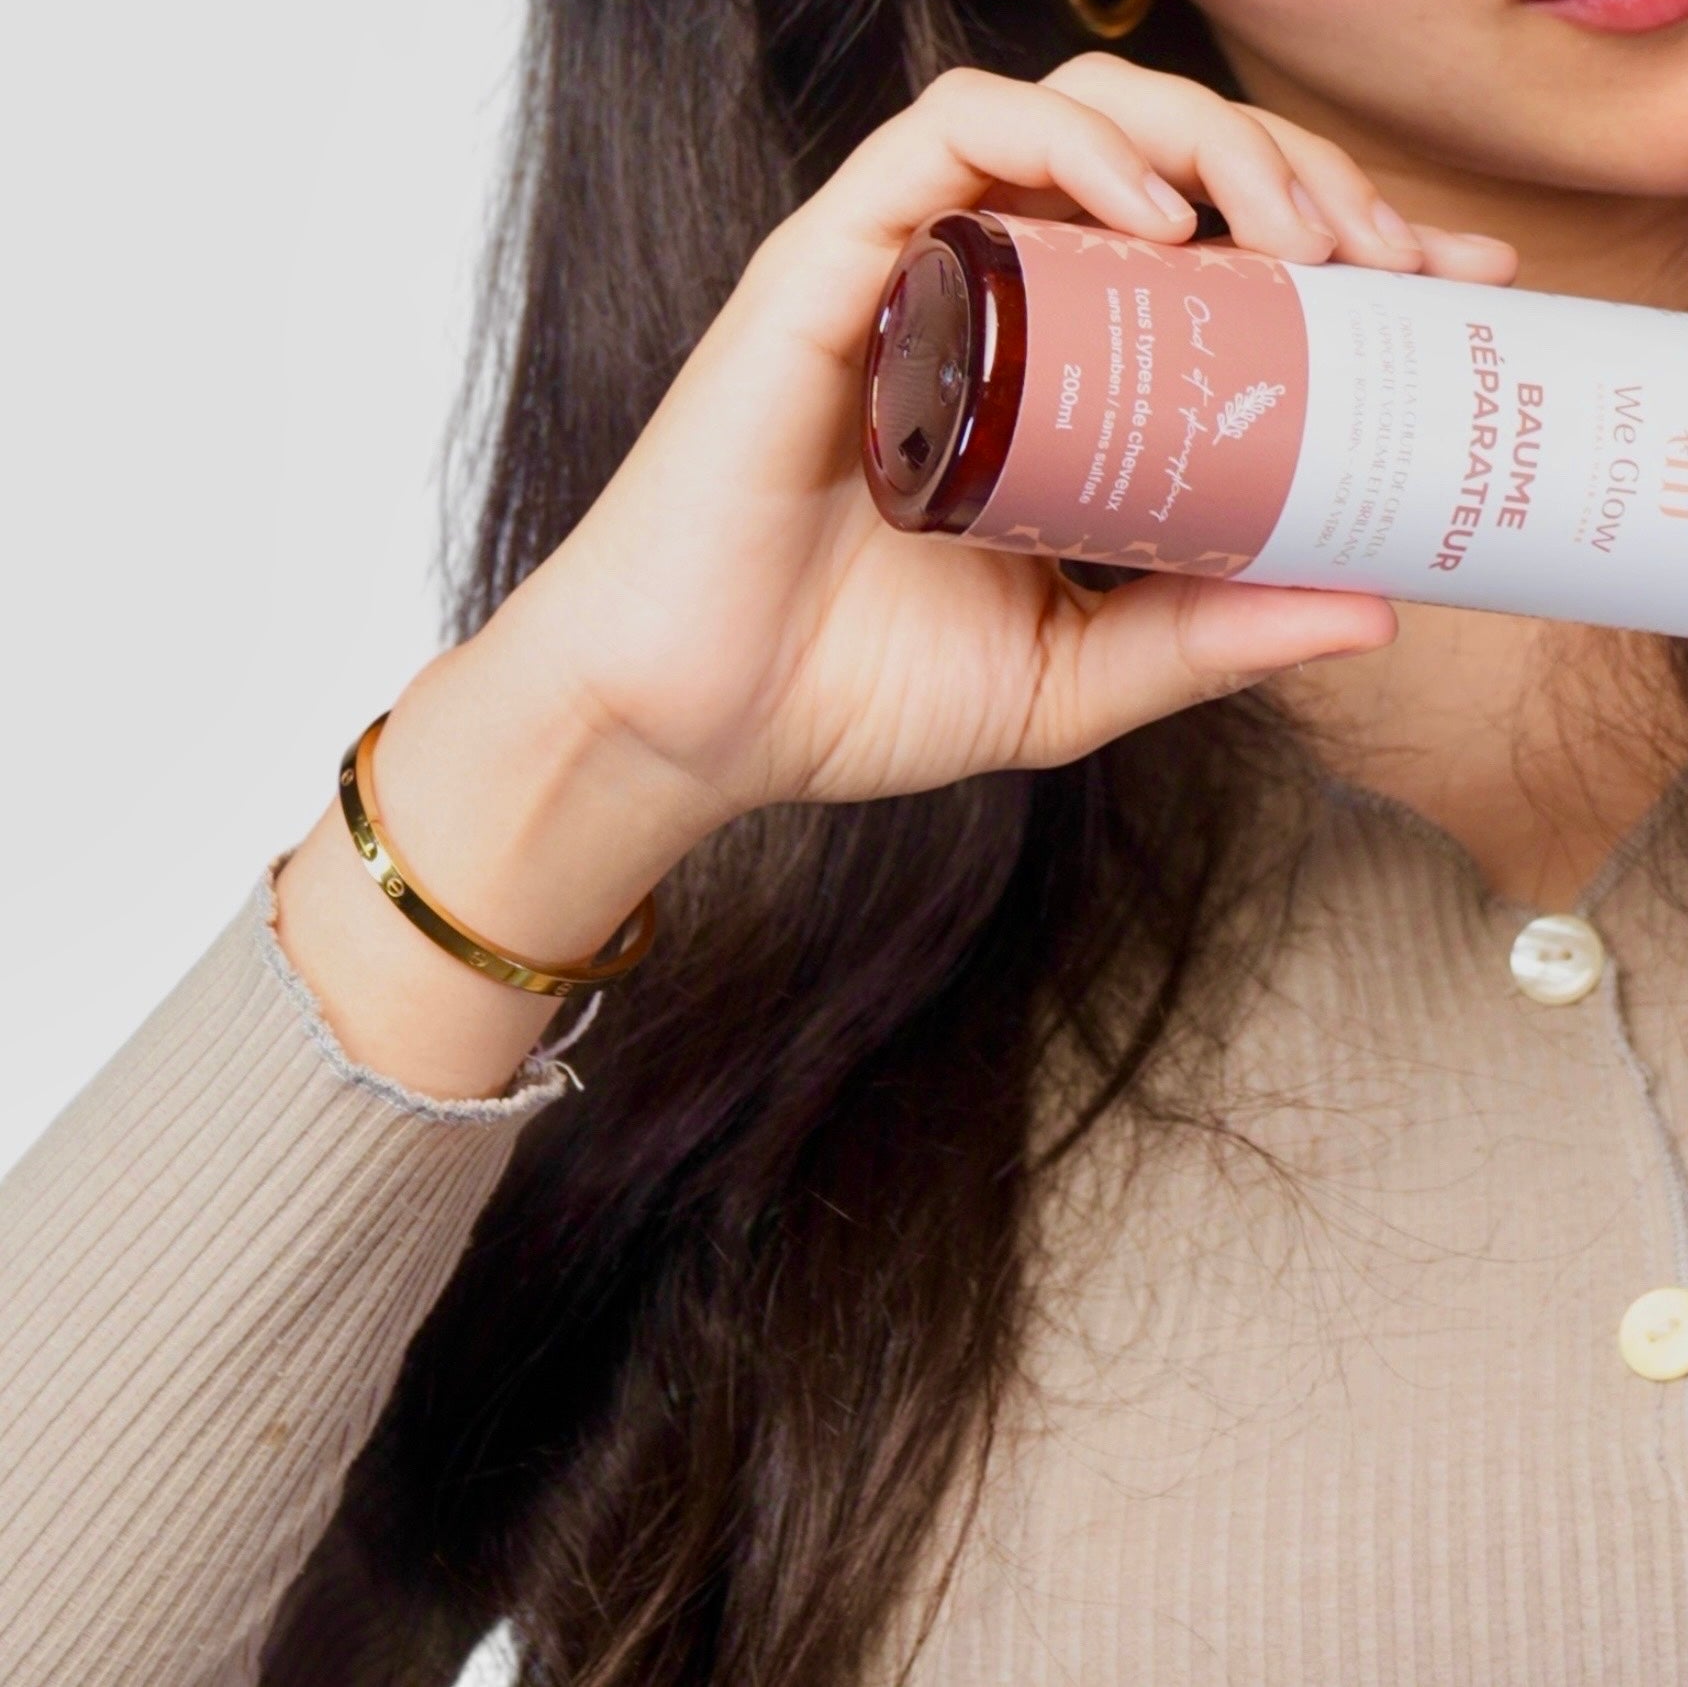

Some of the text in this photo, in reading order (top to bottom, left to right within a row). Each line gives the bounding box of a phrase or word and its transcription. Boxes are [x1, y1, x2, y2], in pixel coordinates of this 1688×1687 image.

[1106, 287, 1121, 322] sans
[1184, 295, 1215, 357] Oud
[1108, 324, 1125, 396] paraben
[1181, 368, 1214, 407] et
[1055, 364, 1082, 431] 200ml
[1098, 409, 1117, 450] sans
[1106, 287, 1155, 511] tous types de cheveux
[1079, 452, 1106, 505] sulfate
[1428, 322, 1505, 572] RÉPARATEUR
[1496, 382, 1544, 529] BAUME
[1591, 386, 1643, 553] We Glow
